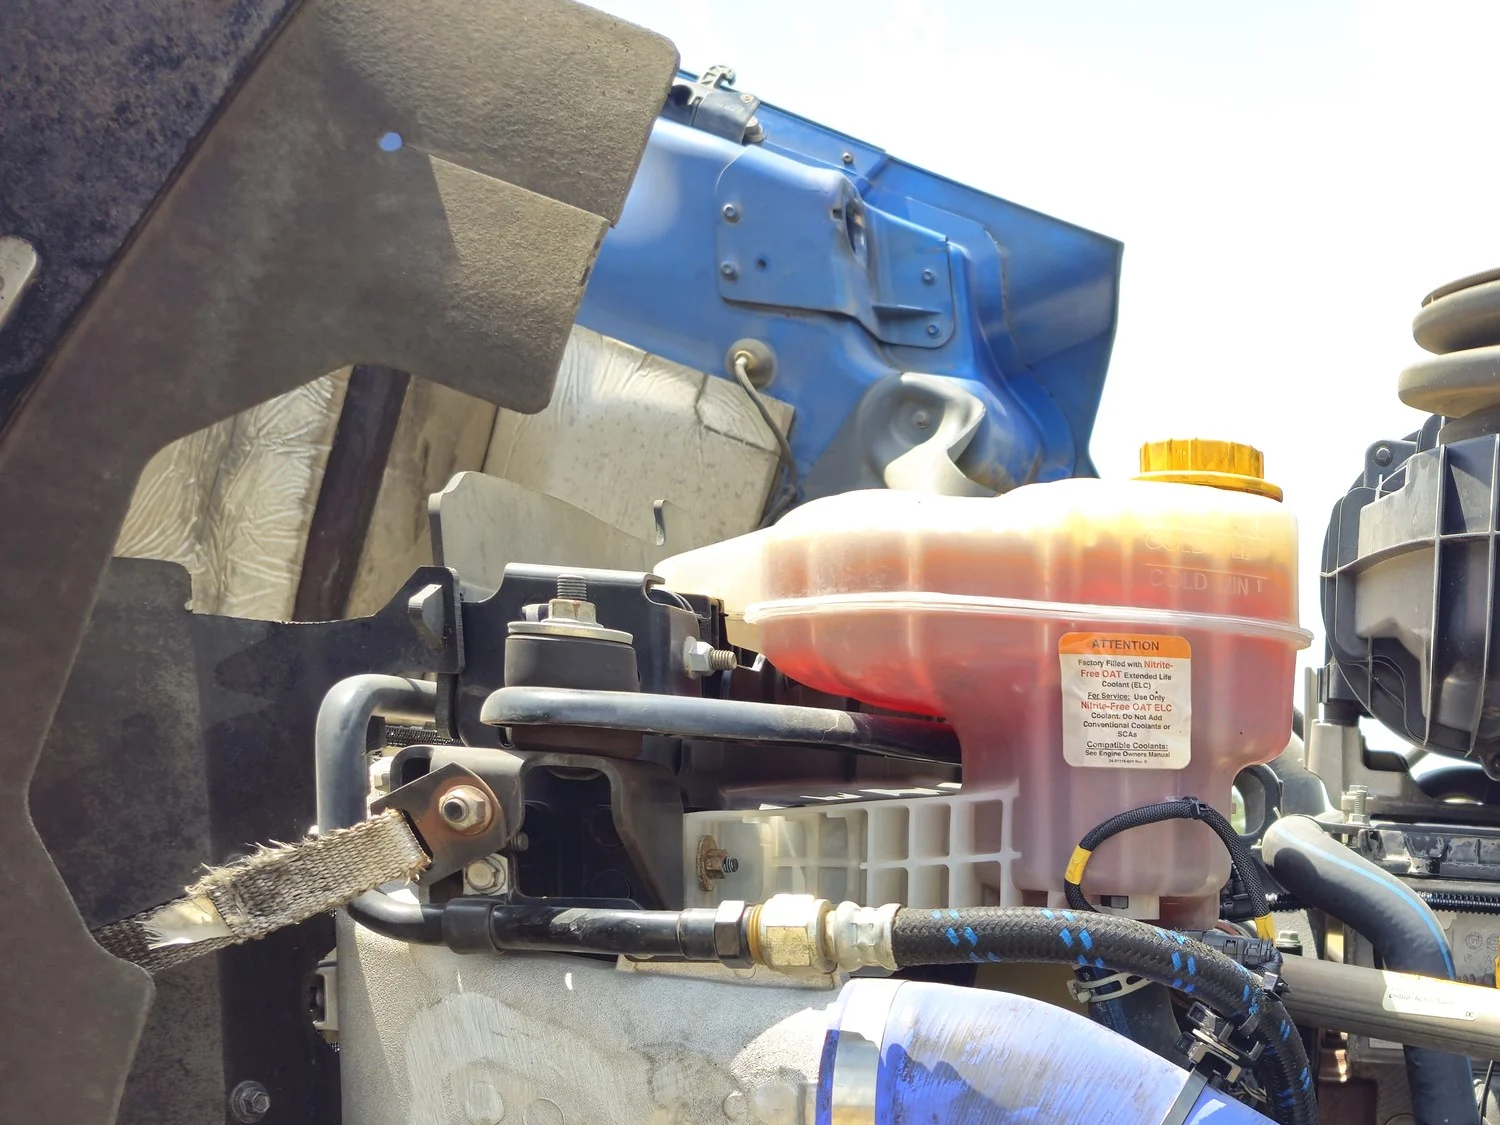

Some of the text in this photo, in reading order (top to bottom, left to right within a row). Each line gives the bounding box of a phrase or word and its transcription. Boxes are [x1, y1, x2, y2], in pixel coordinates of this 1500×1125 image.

[1092, 639, 1160, 651] ATTENTION
[1078, 659, 1104, 667] Factory
[1144, 660, 1174, 670] Nitrite-
[1080, 669, 1100, 678] Free
[1102, 670, 1122, 678] OAT
[1124, 672, 1158, 680] Extended
[1102, 680, 1151, 690] Coolant (ELC)
[1088, 692, 1165, 702] For Service: Use Only
[1081, 701, 1172, 712] Nitrite-Free OAT ELC
[1091, 712, 1121, 720] Coolant.
[1083, 721, 1130, 729] Conventional
[1131, 722, 1162, 730] Coolants
[1086, 741, 1168, 751] Compatible Coolants:
[1099, 750, 1121, 758] Engine
